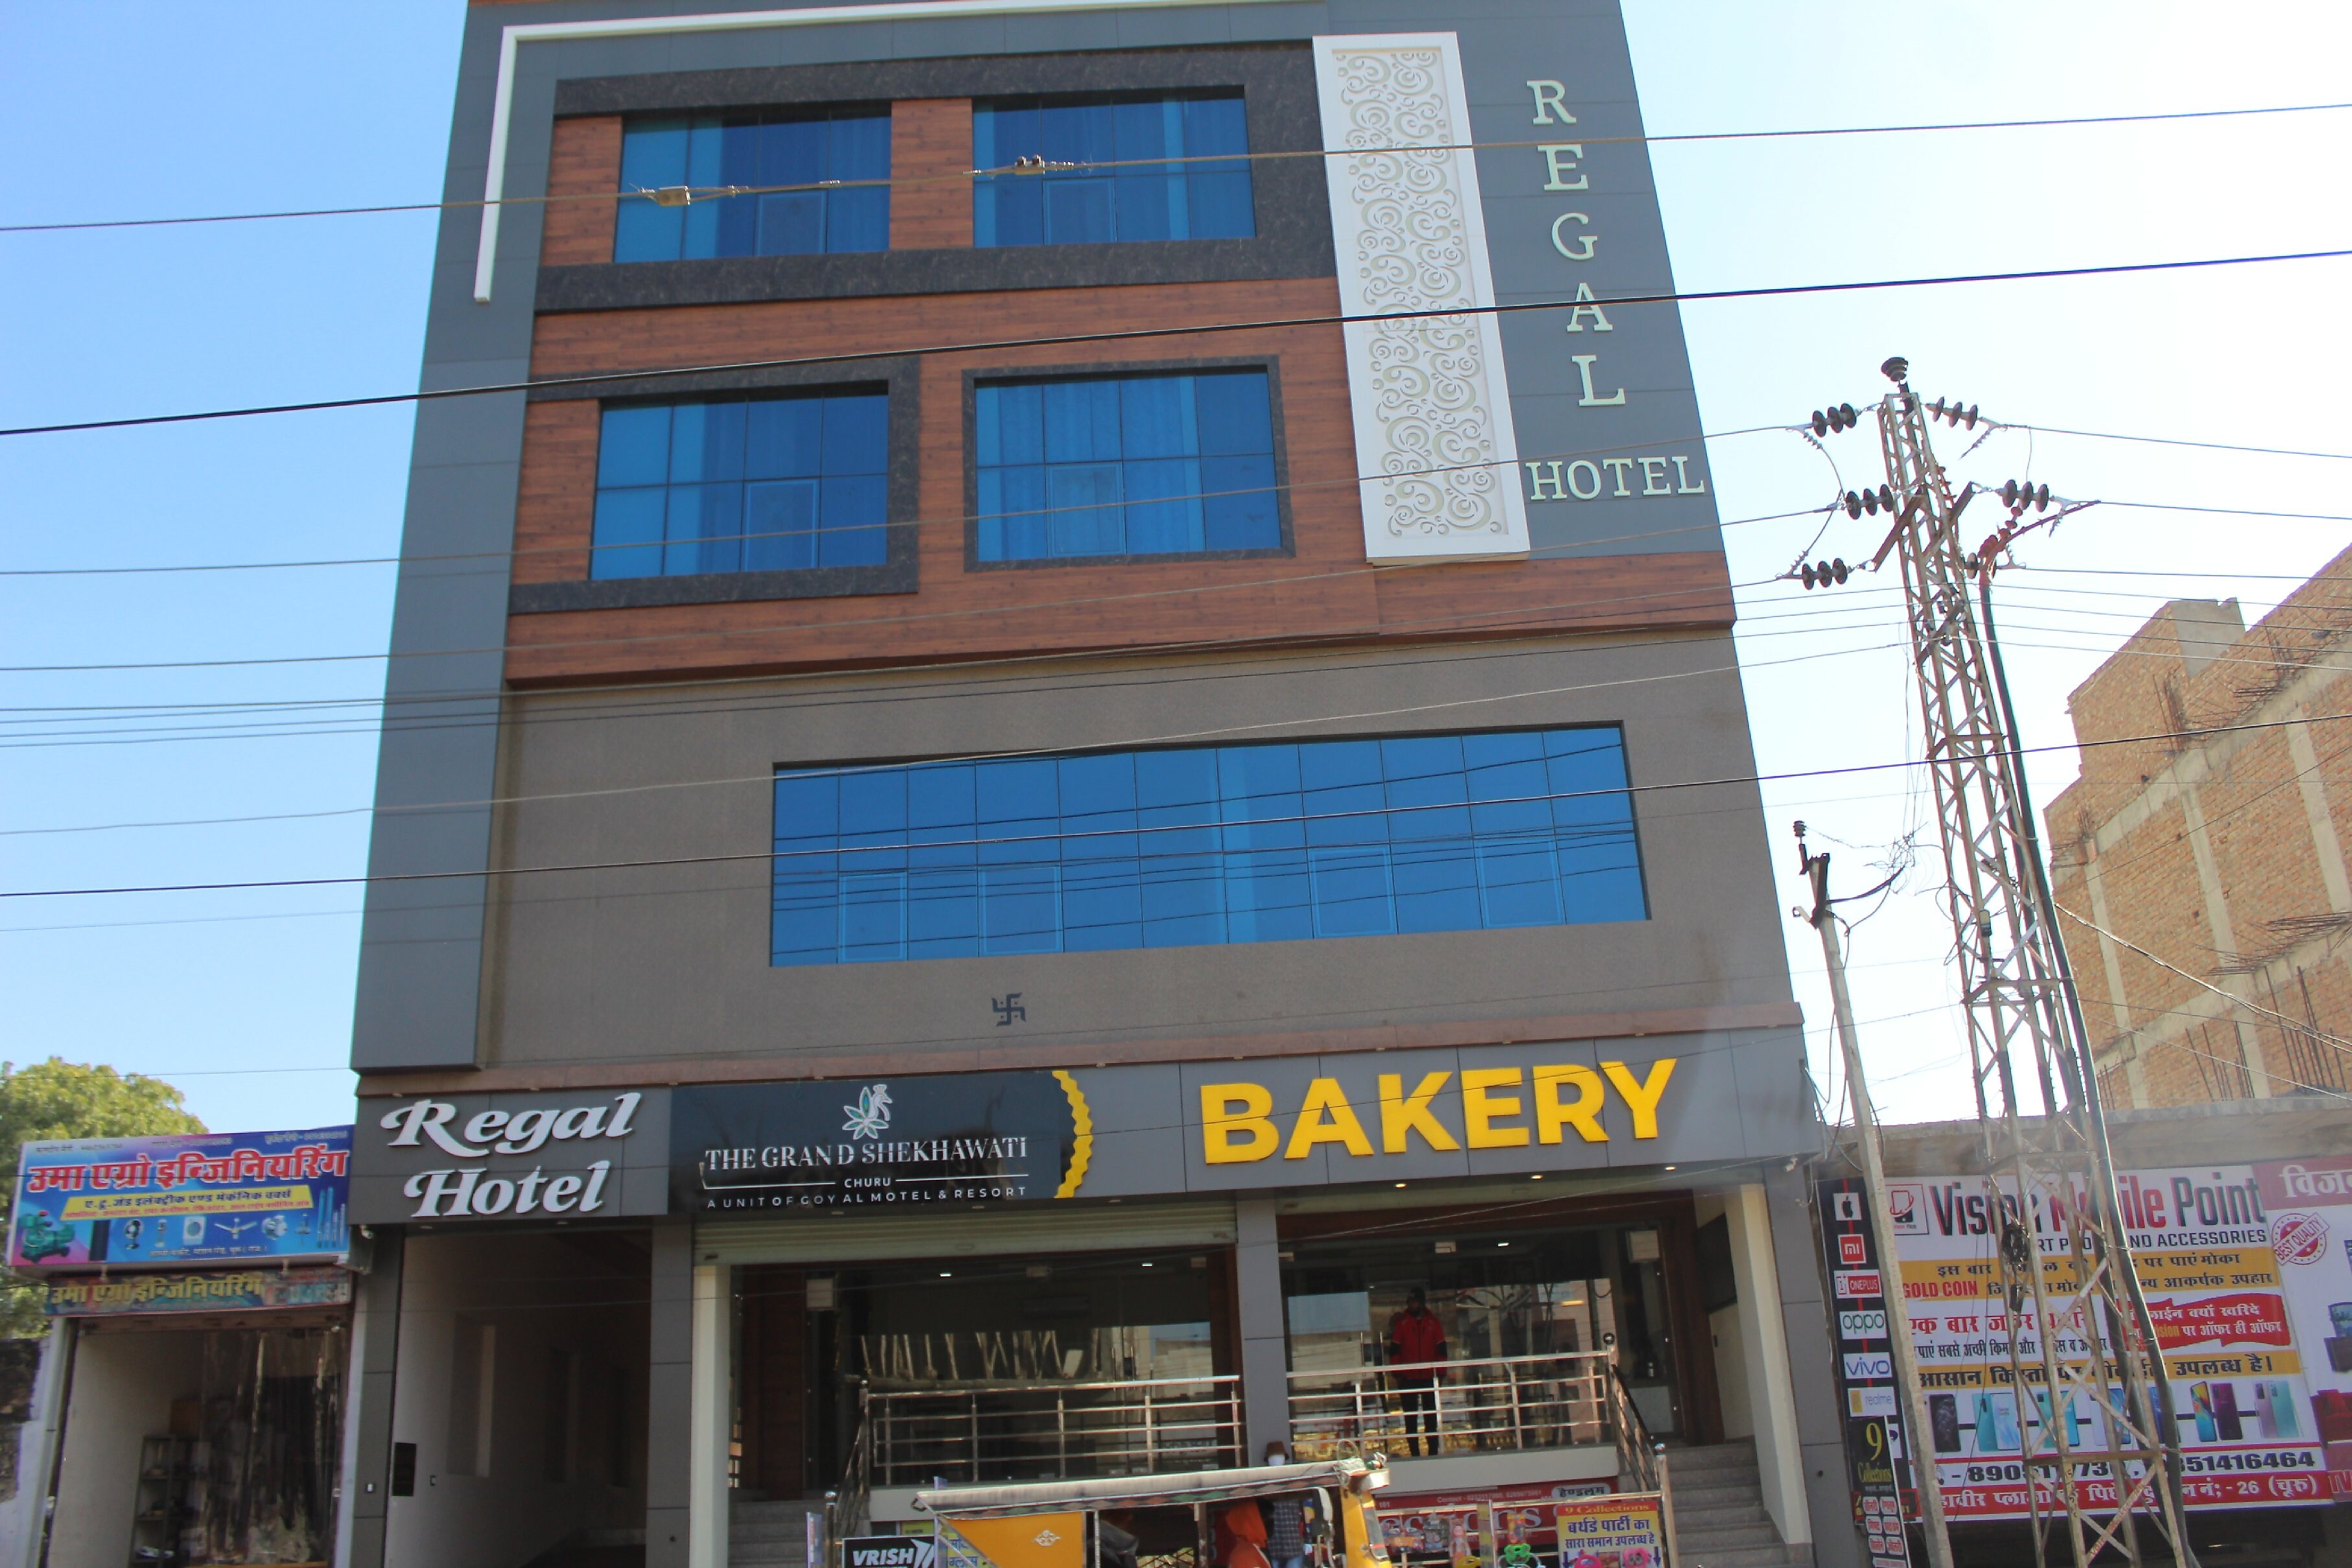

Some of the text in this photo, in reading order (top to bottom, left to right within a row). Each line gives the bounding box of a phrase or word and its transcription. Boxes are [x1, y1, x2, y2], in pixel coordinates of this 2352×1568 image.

[1526, 80, 1625, 406] REGAL
[1525, 456, 1704, 500] HOTEL
[1200, 1058, 1677, 1165] BAKERY
[381, 1092, 641, 1157] Regal
[705, 1137, 1028, 1170] THE GRAND SHEKHAWATI
[28, 1165, 88, 1193] उमा
[91, 1153, 153, 1189] एग्रो
[845, 1177, 891, 1188] CHURU
[404, 1160, 611, 1218] Hotel
[707, 1199, 715, 1208] A
[723, 1197, 765, 1207] UNIT
[772, 1196, 793, 1206] OF
[871, 1191, 930, 1202] MOTEL
[939, 1190, 947, 1199] &
[955, 1187, 1026, 1199] RESORT
[2170, 1172, 2266, 1228] Point
[2158, 1230, 2266, 1248] ACCESSORIES
[2274, 1217, 2323, 1261] BEST QUALITY
[1936, 1265, 1960, 1278] इस
[2143, 1258, 2163, 1267] पर
[1850, 1280, 1878, 1291] ONEPLUS
[1903, 1281, 1938, 1298] GOLD
[1943, 1280, 1978, 1296] COIN
[1843, 1314, 1885, 1334] oppo
[1944, 1316, 1979, 1333] बार
[1846, 1357, 1890, 1375] vivo
[2173, 1359, 2240, 1375] उपलब्ध
[1865, 1394, 1892, 1406] realme
[1577, 1504, 1650, 1514] Collections
[1634, 1519, 1649, 1530] का
[1565, 1538, 1584, 1549] सारा
[853, 1548, 915, 1567] VRISH
